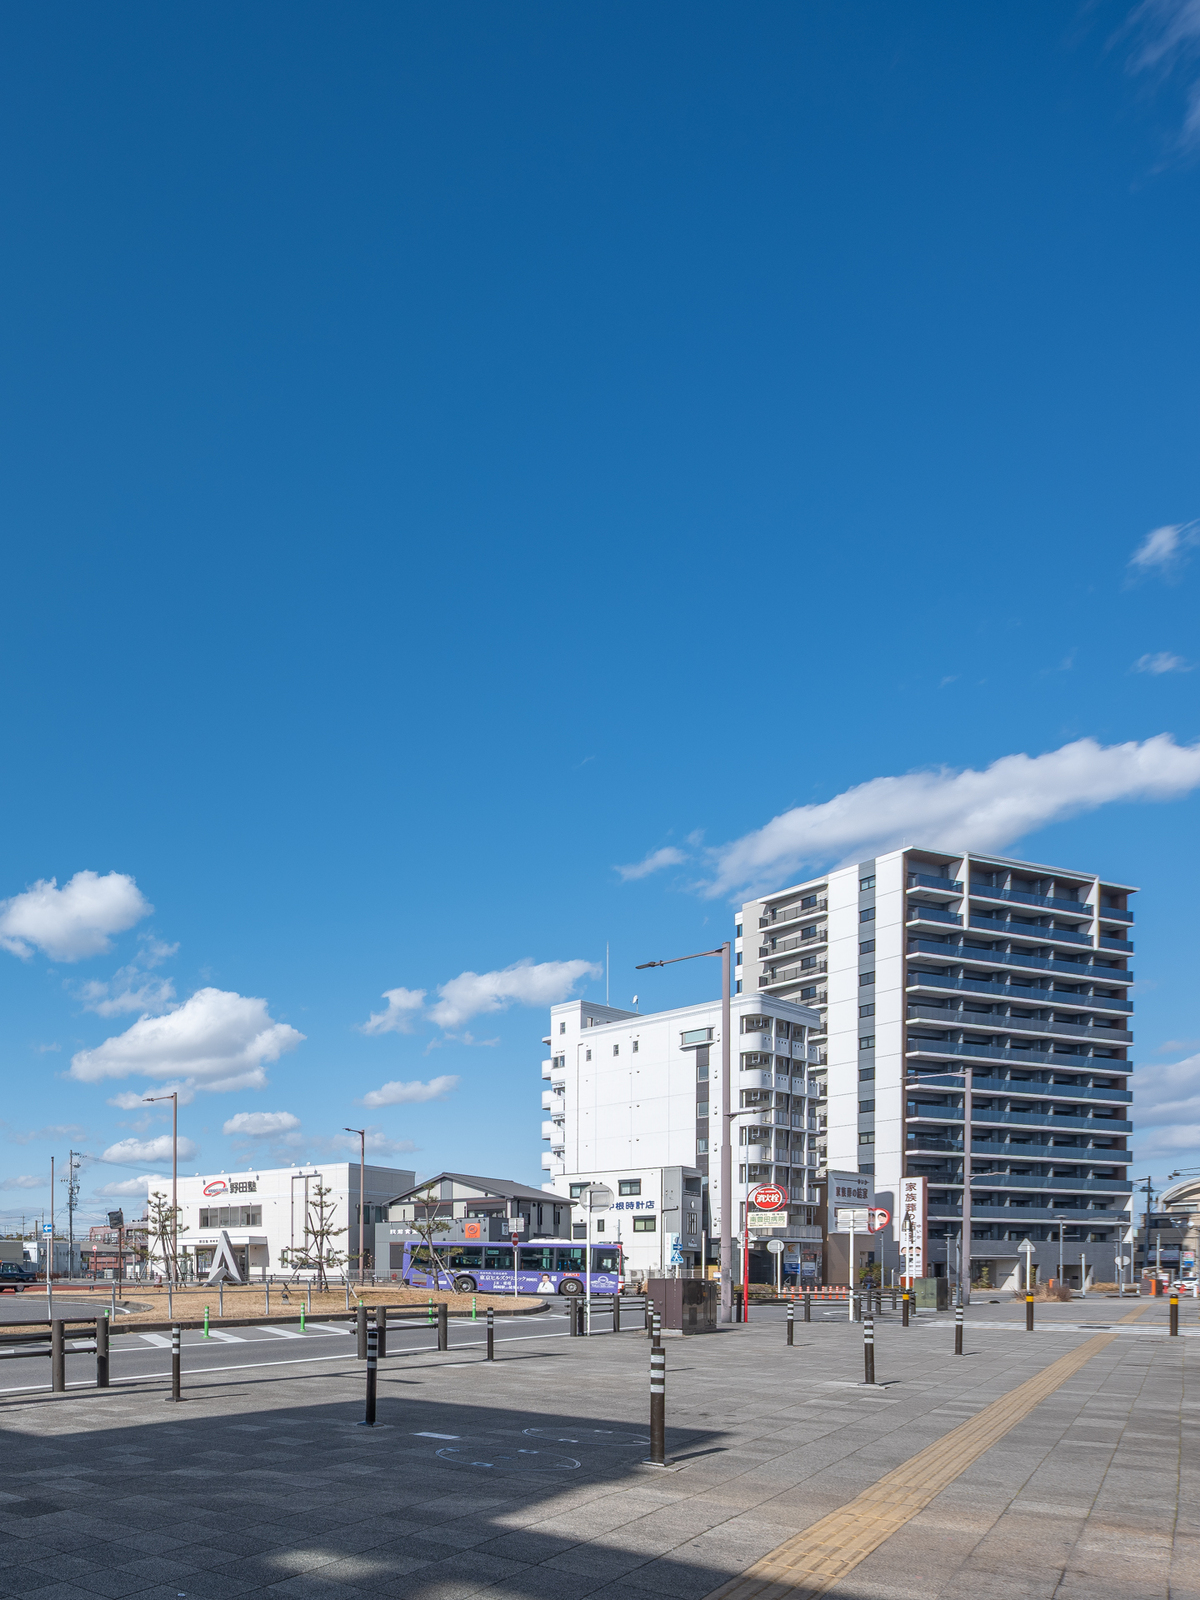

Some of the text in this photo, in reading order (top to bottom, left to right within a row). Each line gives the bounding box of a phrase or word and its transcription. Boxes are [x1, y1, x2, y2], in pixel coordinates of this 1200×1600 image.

[229, 1181, 257, 1194] 野田塾
[835, 1186, 869, 1199] 家族葬の結家
[756, 1193, 780, 1203] 消火栓
